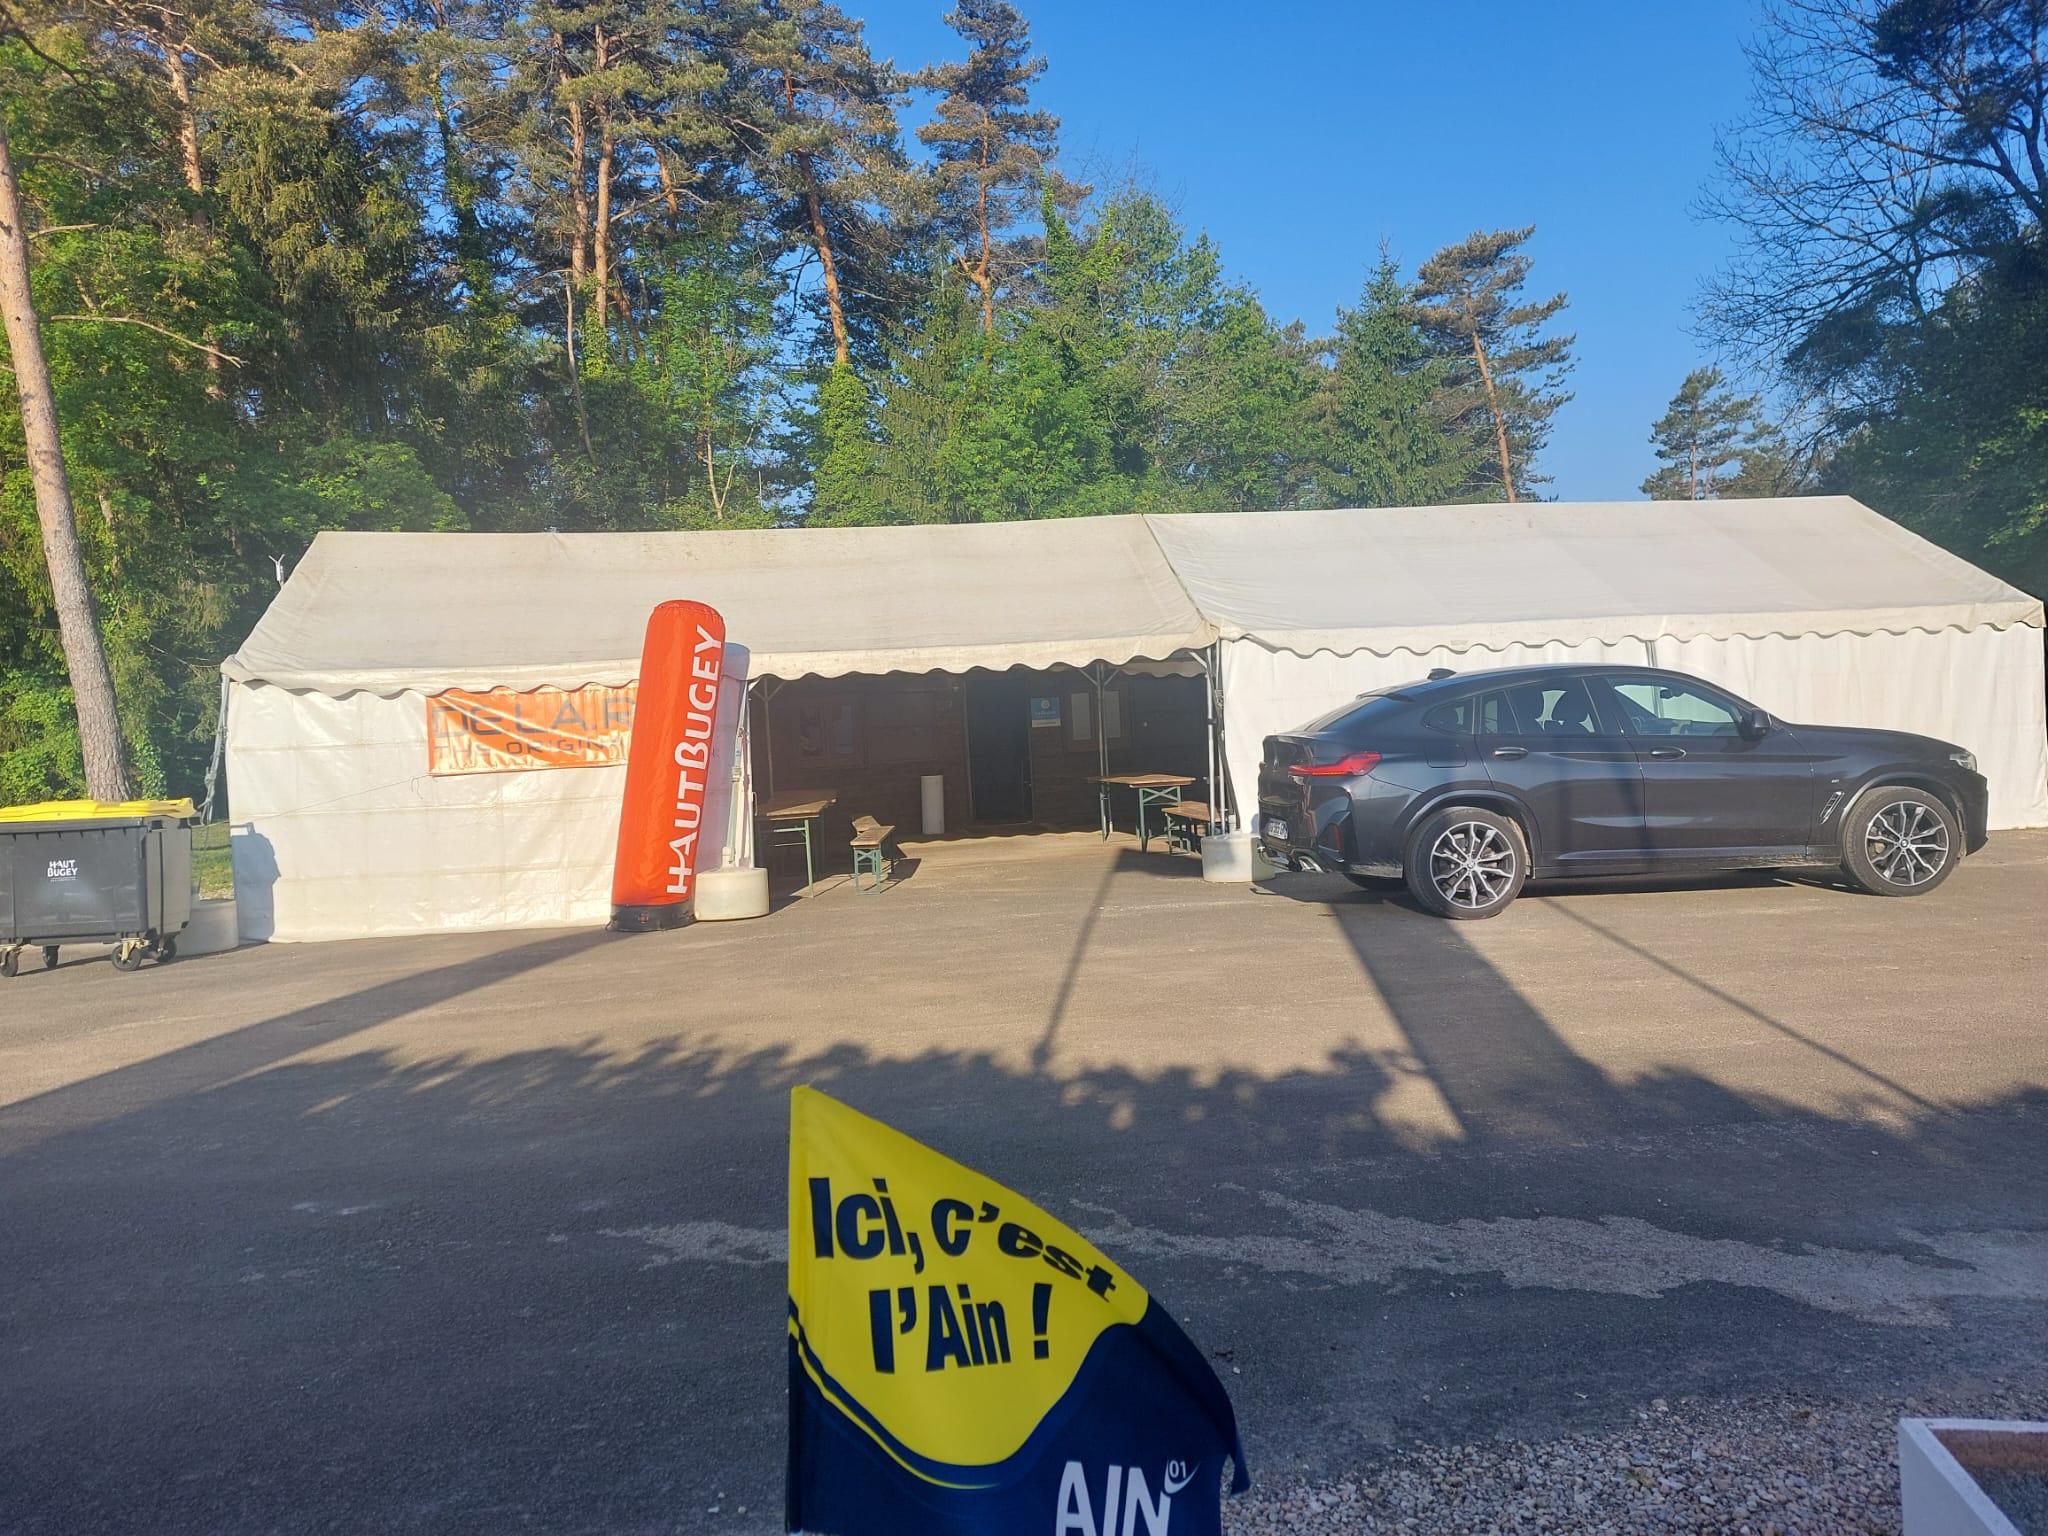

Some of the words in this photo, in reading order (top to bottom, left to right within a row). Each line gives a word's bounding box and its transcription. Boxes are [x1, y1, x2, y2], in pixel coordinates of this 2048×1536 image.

[47, 867, 79, 878] BUGEY
[49, 859, 76, 869] HAUT
[808, 1176, 925, 1275] Ici,
[1055, 1461, 1172, 1536] AIN
[1168, 1459, 1187, 1479] 01
